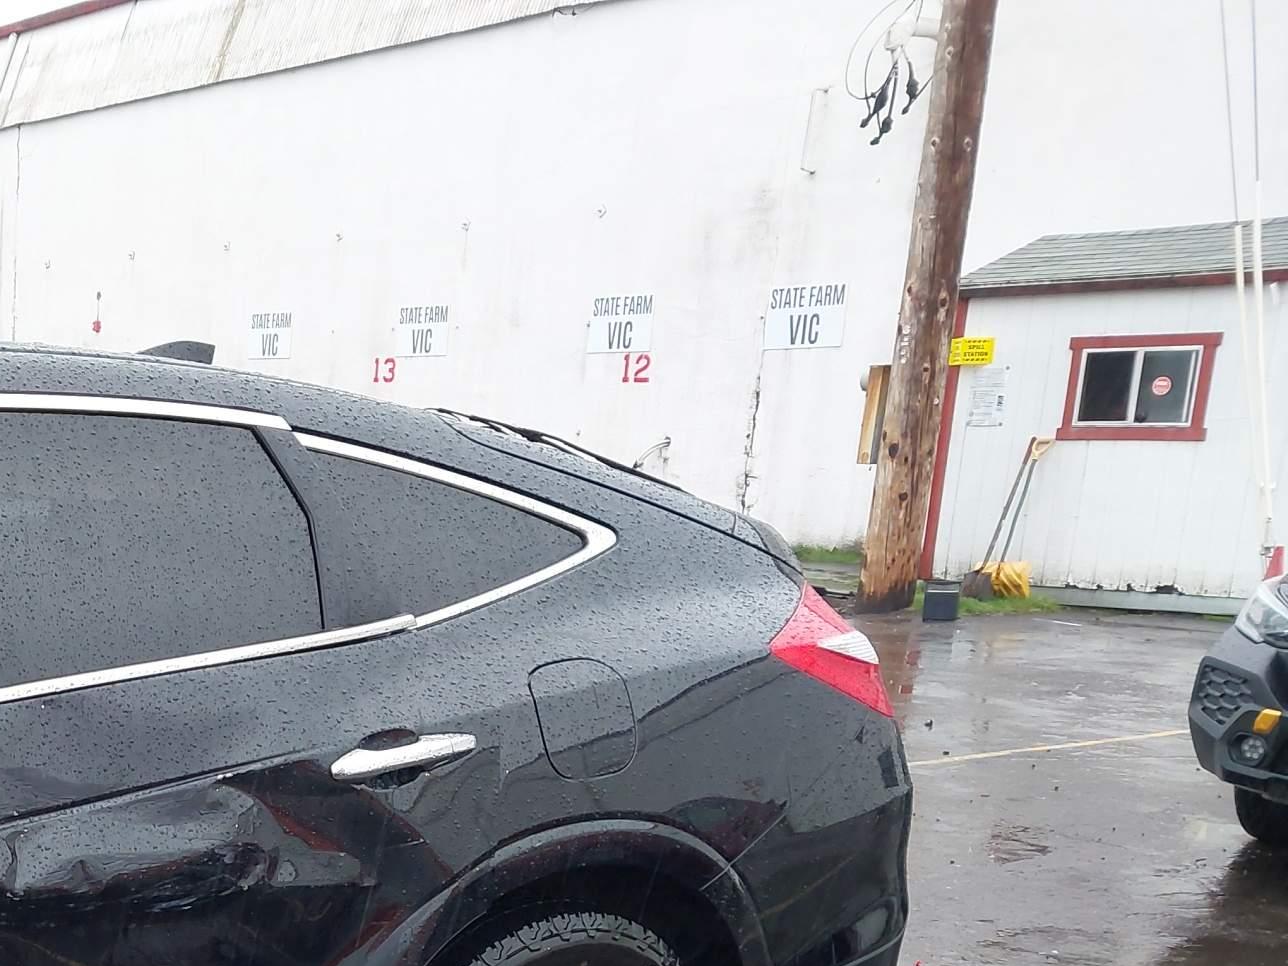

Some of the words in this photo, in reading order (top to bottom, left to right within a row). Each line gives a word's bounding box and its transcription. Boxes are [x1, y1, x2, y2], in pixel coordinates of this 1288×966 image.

[593, 297, 621, 317] STATE
[623, 295, 653, 315] FARM
[770, 286, 807, 310] STATE
[808, 284, 846, 308] FARM
[251, 313, 270, 329] STATE
[271, 312, 292, 329] FARM
[399, 307, 423, 324] STATE
[424, 305, 448, 323] FARM
[412, 328, 433, 354] VIC
[608, 320, 633, 349] VIC
[789, 313, 820, 346] VIC
[261, 333, 279, 357] VIC
[373, 357, 396, 383] 13
[622, 353, 651, 383] 12
